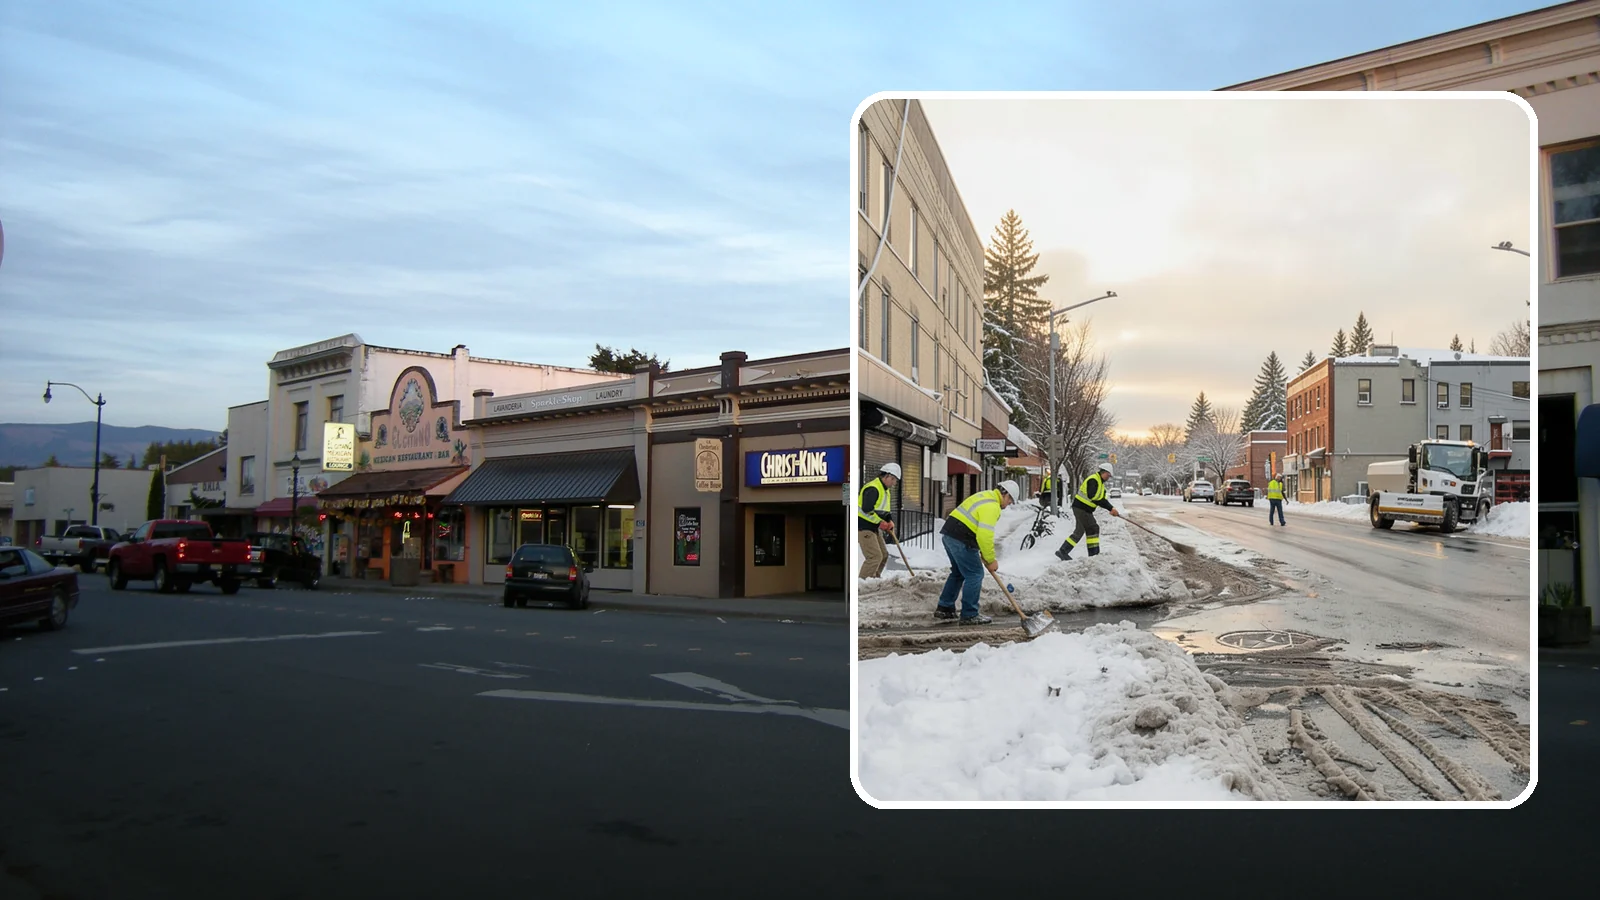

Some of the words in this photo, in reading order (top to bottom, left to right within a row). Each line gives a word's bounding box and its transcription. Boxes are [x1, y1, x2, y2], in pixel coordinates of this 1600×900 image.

[562, 394, 583, 405] Shop
[596, 389, 624, 399] LAUNDRY
[493, 402, 523, 413] LAVANDERIA
[373, 455, 397, 464] MEXICAN
[397, 451, 433, 462] RESTAURANT
[437, 450, 450, 459] BAR
[761, 452, 797, 477] CHRIST
[799, 450, 827, 476] KING
